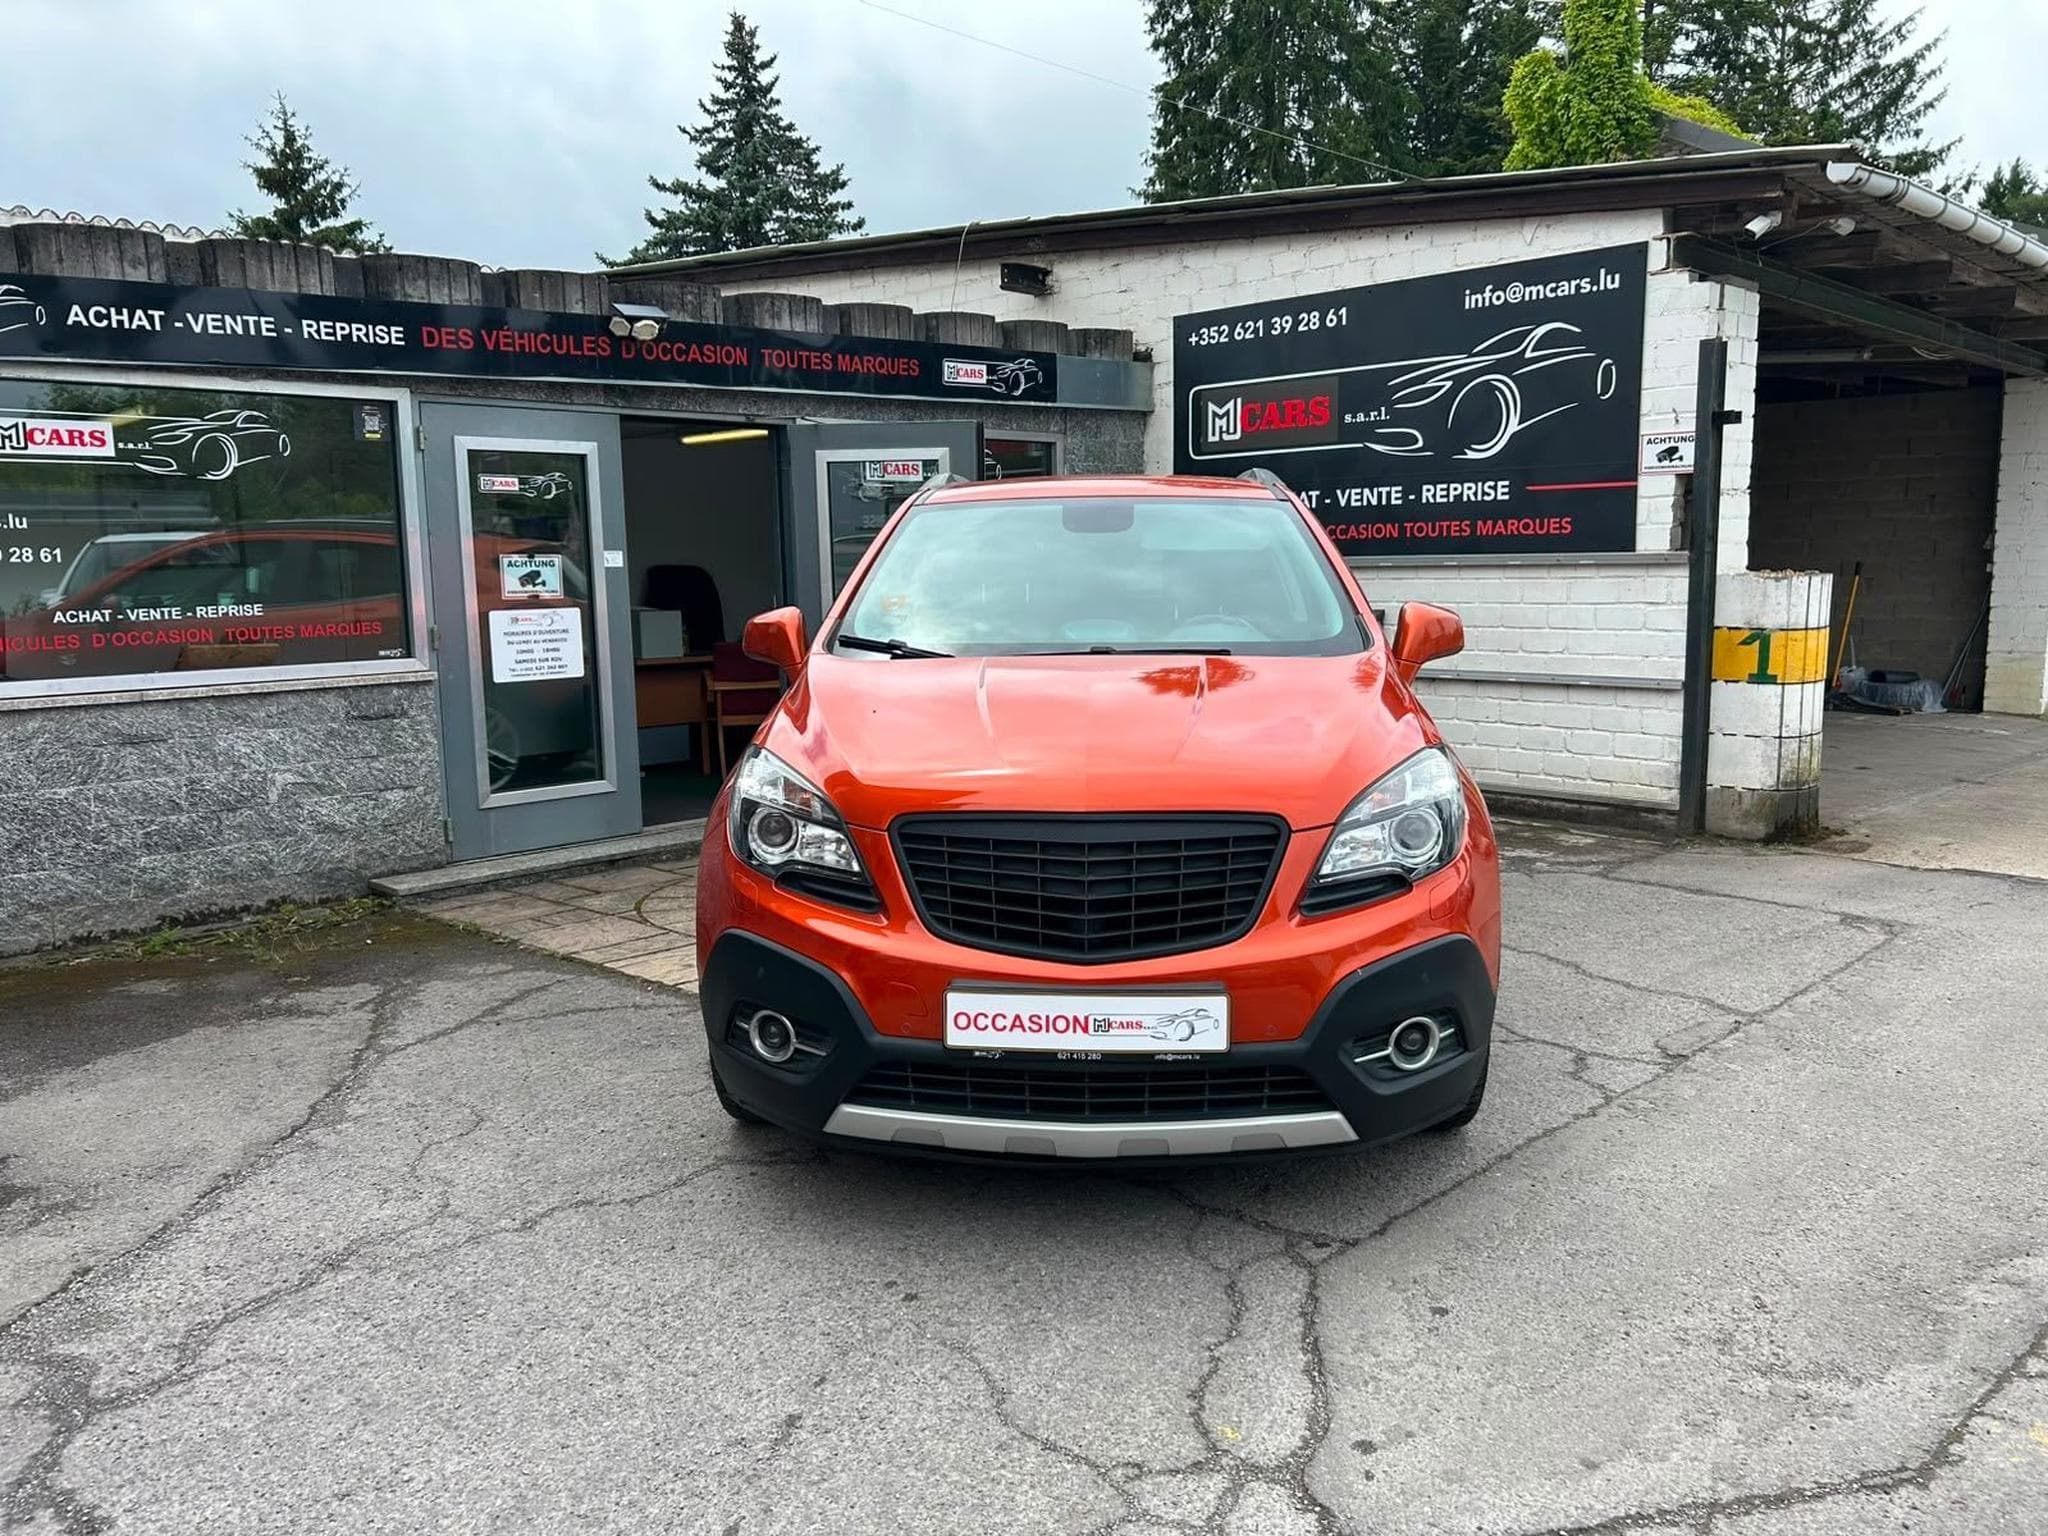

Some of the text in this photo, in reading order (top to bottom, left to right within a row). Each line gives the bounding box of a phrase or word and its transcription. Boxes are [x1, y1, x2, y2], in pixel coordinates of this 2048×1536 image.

[1464, 267, 1620, 310] info@mcars.lu
[1188, 306, 1347, 346] +352 621 39 28 61
[66, 304, 165, 332] ACHAT
[302, 319, 405, 346] REPRISE
[421, 325, 475, 350] DES
[482, 326, 612, 357] VÉHICULES
[621, 338, 748, 366] D'OCCASION
[761, 348, 833, 371] TOUTES
[837, 354, 921, 377] MARQUES
[1646, 434, 1695, 446] ACHTUNG
[1336, 486, 1403, 507] VENTE
[1421, 481, 1510, 503] REPRISE
[1327, 517, 1573, 540] CCASION TOUTES MARQUES
[9, 547, 62, 563] 28 61
[507, 559, 556, 568] ACHTUNG
[53, 609, 112, 624] ACHAT
[126, 607, 182, 621] VENTE
[196, 604, 264, 618] REPRISE
[92, 628, 214, 648] D'OCCASION
[225, 625, 295, 642] TOUTES
[300, 621, 383, 639] MARQUES
[1738, 631, 1778, 683] 1
[953, 1011, 1089, 1034] OCCASION
